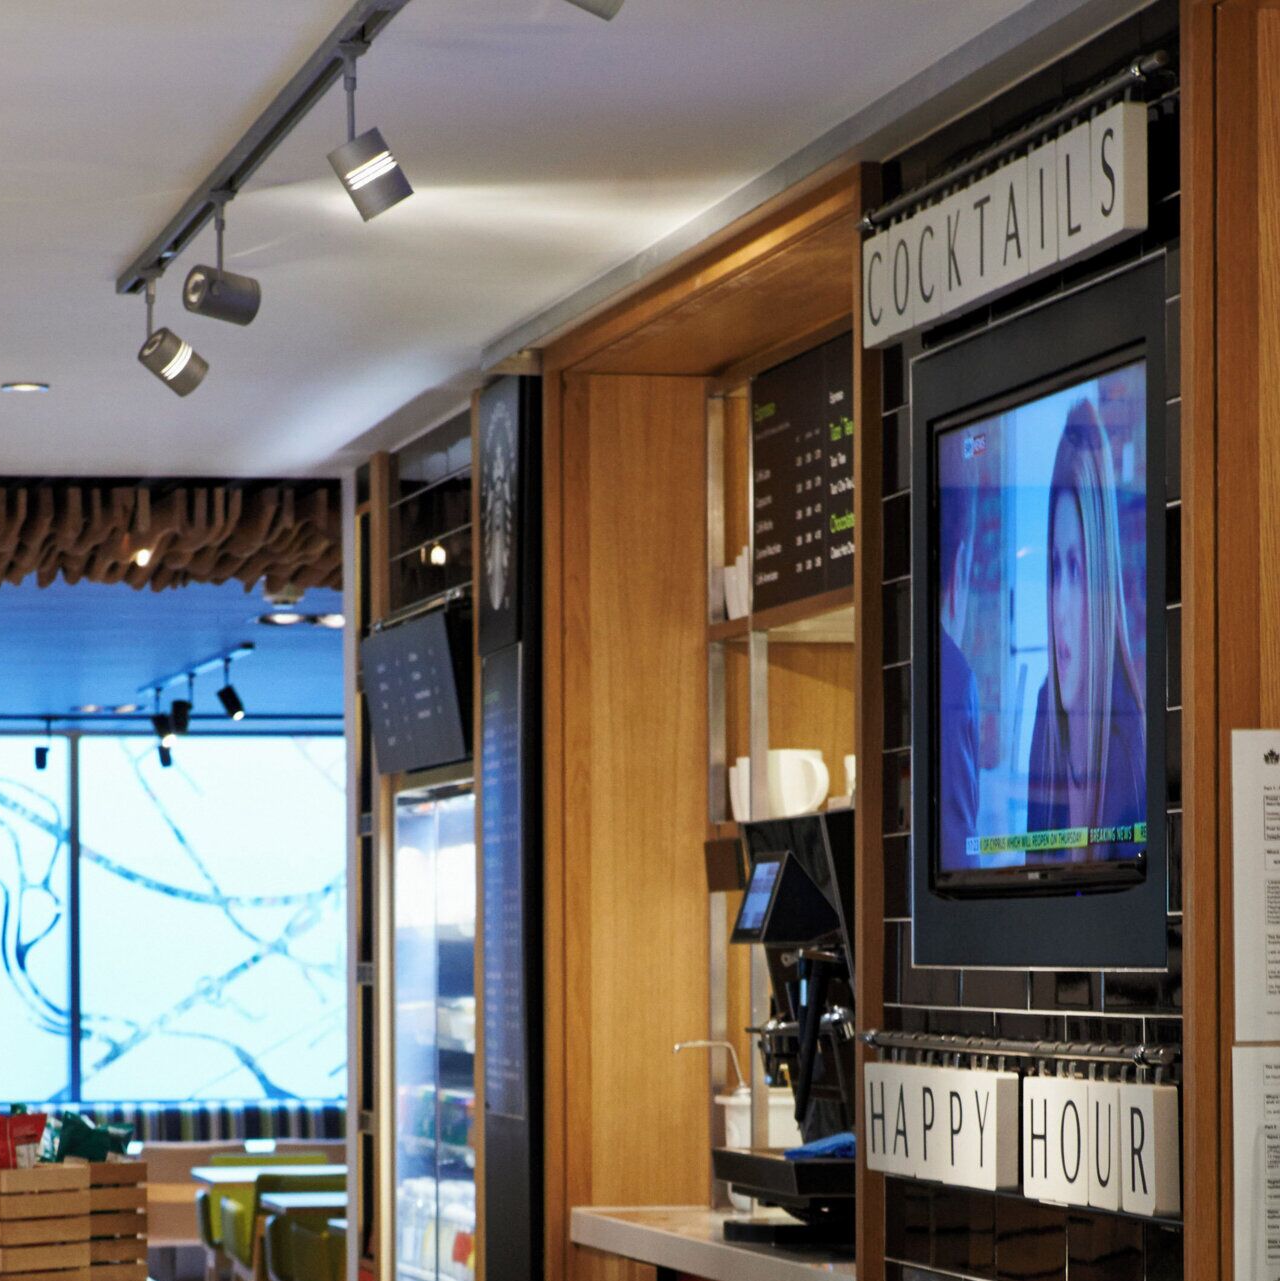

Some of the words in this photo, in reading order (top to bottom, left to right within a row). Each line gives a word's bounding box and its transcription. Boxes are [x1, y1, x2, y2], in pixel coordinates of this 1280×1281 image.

[868, 128, 1115, 326] COCKTAILS
[870, 1081, 989, 1167] HAPPY
[1030, 1099, 1147, 1194] HOUR
